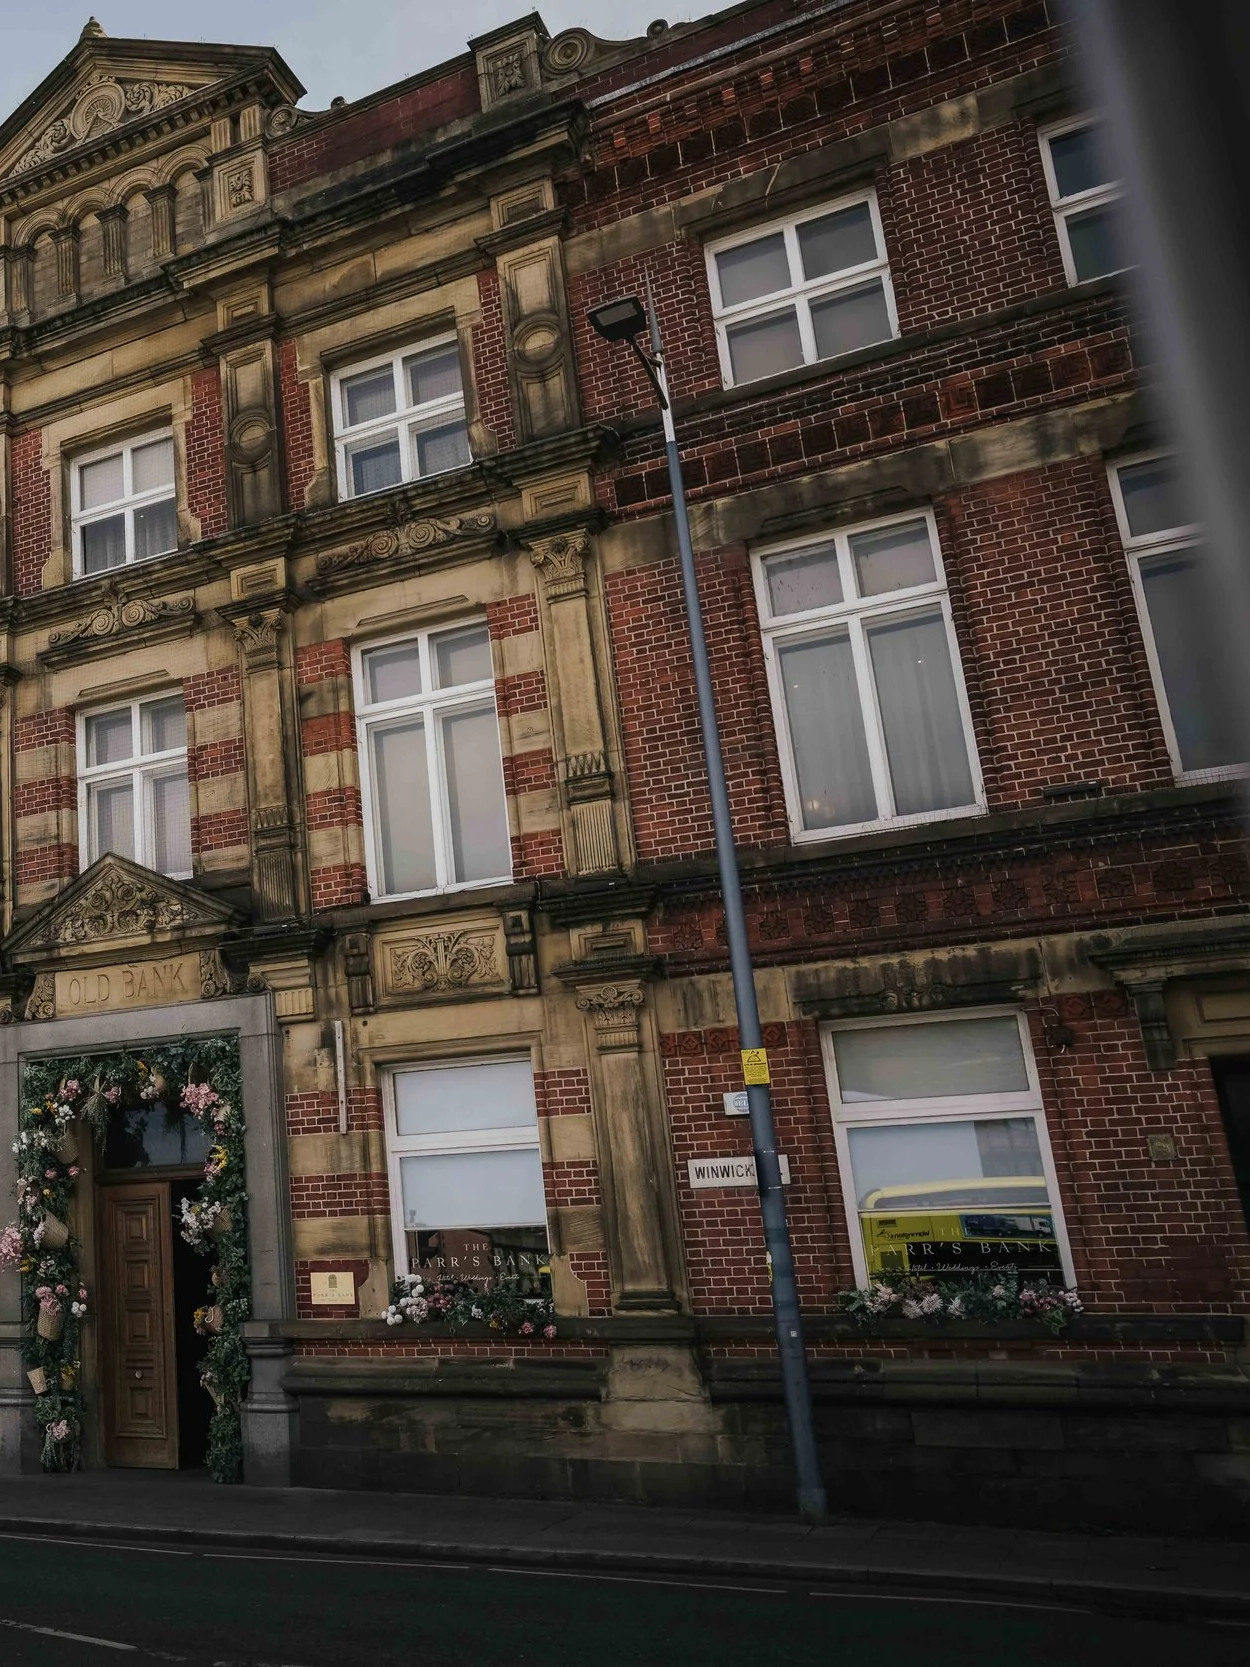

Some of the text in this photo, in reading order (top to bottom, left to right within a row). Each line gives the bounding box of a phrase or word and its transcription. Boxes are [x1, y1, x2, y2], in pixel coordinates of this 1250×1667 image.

[68, 962, 186, 1006] OLD BANK
[694, 1163, 754, 1180] WINWICK
[463, 1243, 489, 1252] THE
[869, 1239, 1053, 1257] PARR'S BANK
[411, 1253, 546, 1269] PARR'S BANK
[936, 1262, 982, 1275] Weddings
